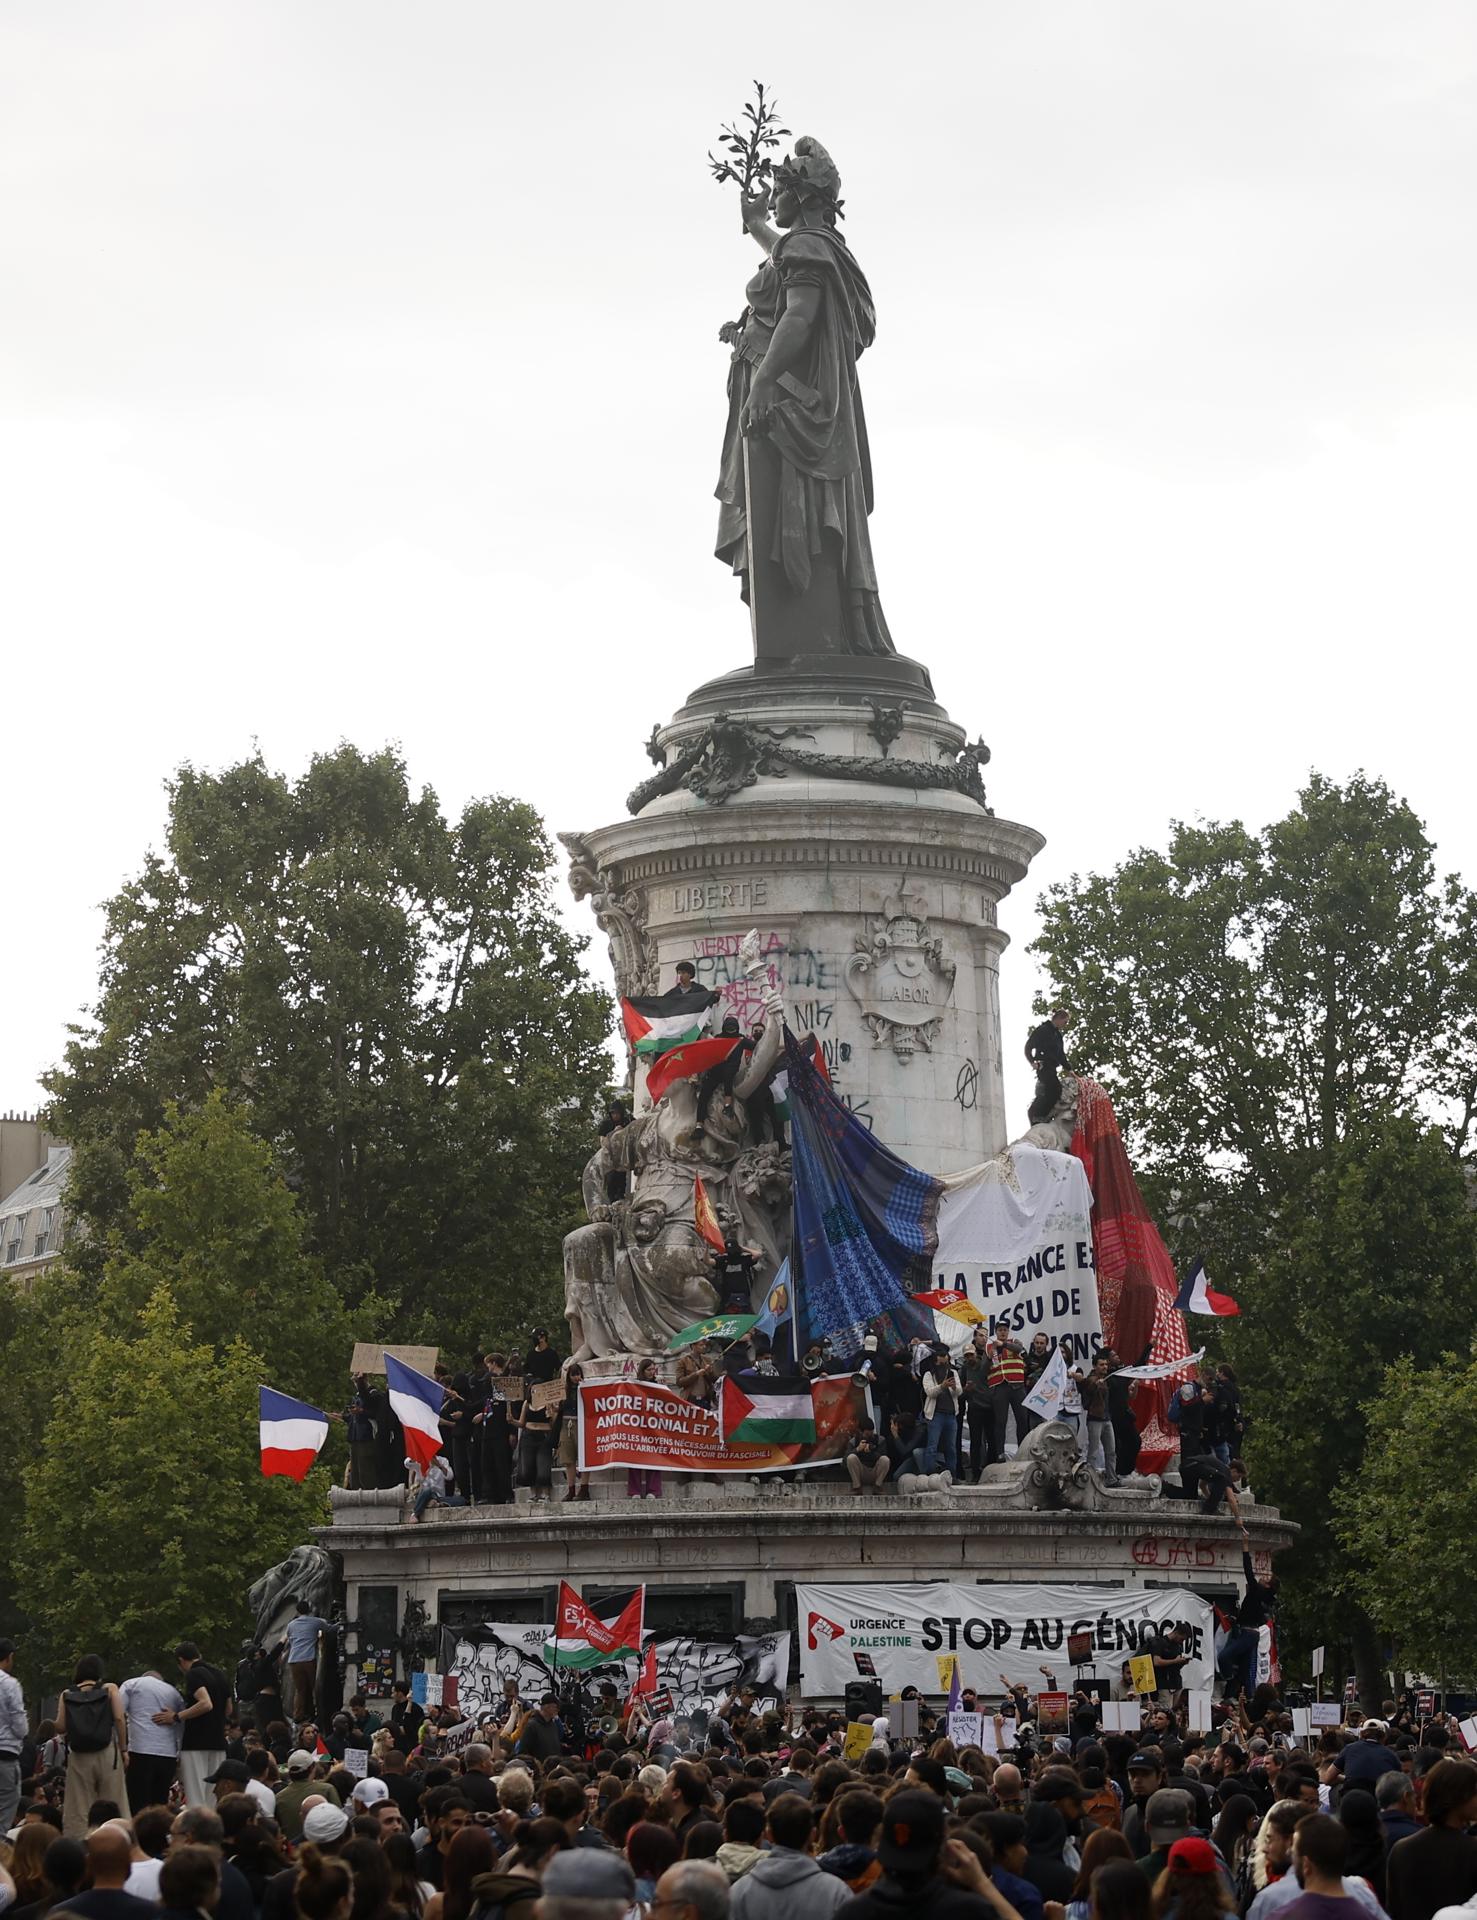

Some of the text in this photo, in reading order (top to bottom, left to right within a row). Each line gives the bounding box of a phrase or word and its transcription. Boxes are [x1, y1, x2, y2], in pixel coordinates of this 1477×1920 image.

[673, 878, 767, 913] LIBERTÉ
[881, 985, 929, 1004] LABOR
[794, 1000, 834, 1031] NIK
[981, 1244, 1066, 1298] FRANCE
[976, 1288, 1081, 1337] ISSU DE
[594, 1394, 642, 1412] NOTRE
[646, 1398, 699, 1420] FRONT
[596, 1413, 689, 1434] ANTICOLONIAL
[693, 1423, 709, 1436] ET
[596, 1436, 609, 1444] PAR
[628, 1434, 640, 1442] LES
[641, 1435, 673, 1446] MOYENS
[630, 1442, 668, 1454] L'ARRIVÉE
[669, 1447, 680, 1455] AU
[680, 1448, 715, 1458] POUVOIR
[604, 1546, 719, 1564] 14 JUILLET 1789
[1019, 1545, 1073, 1561] JUILLET
[1078, 1545, 1108, 1561] 1790
[850, 1619, 905, 1630] URGENCE
[922, 1617, 1011, 1651] STOP
[1020, 1618, 1064, 1651] AU
[850, 1636, 912, 1648] PALESTINE
